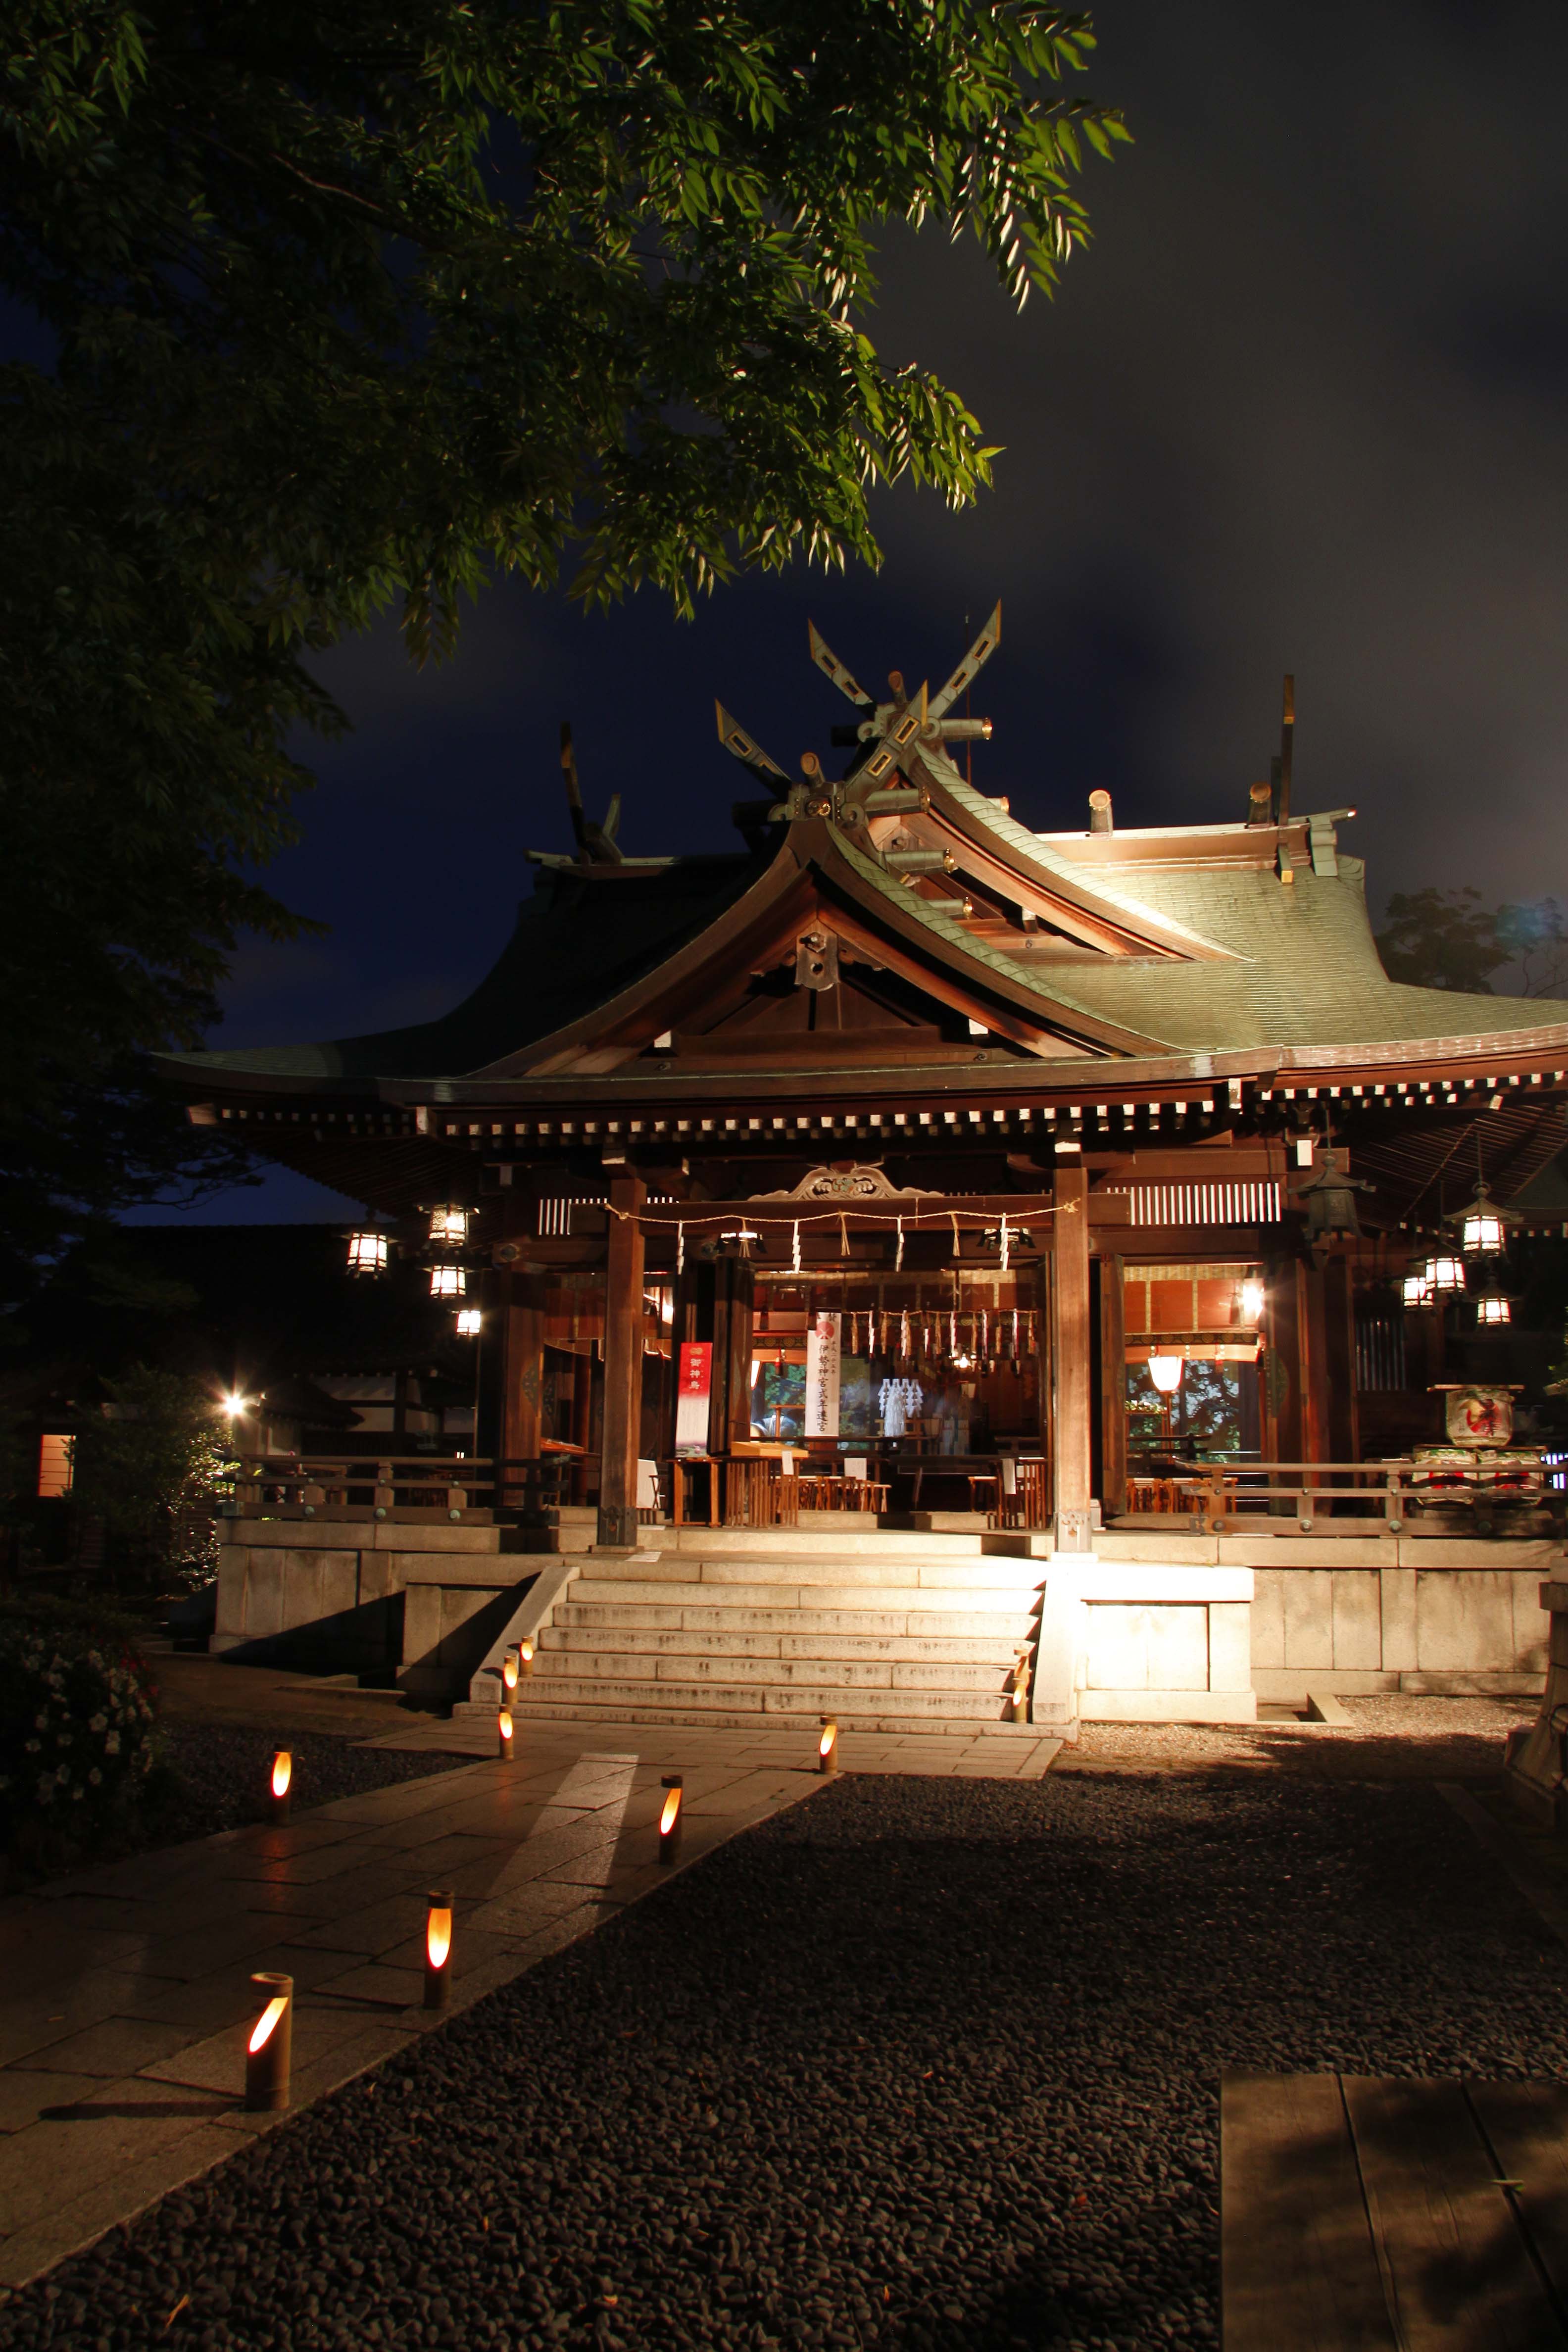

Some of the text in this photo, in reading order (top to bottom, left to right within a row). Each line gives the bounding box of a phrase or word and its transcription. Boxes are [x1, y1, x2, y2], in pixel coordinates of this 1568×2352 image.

[816, 1344, 829, 1431] 伊勢神宮式年遷宮
